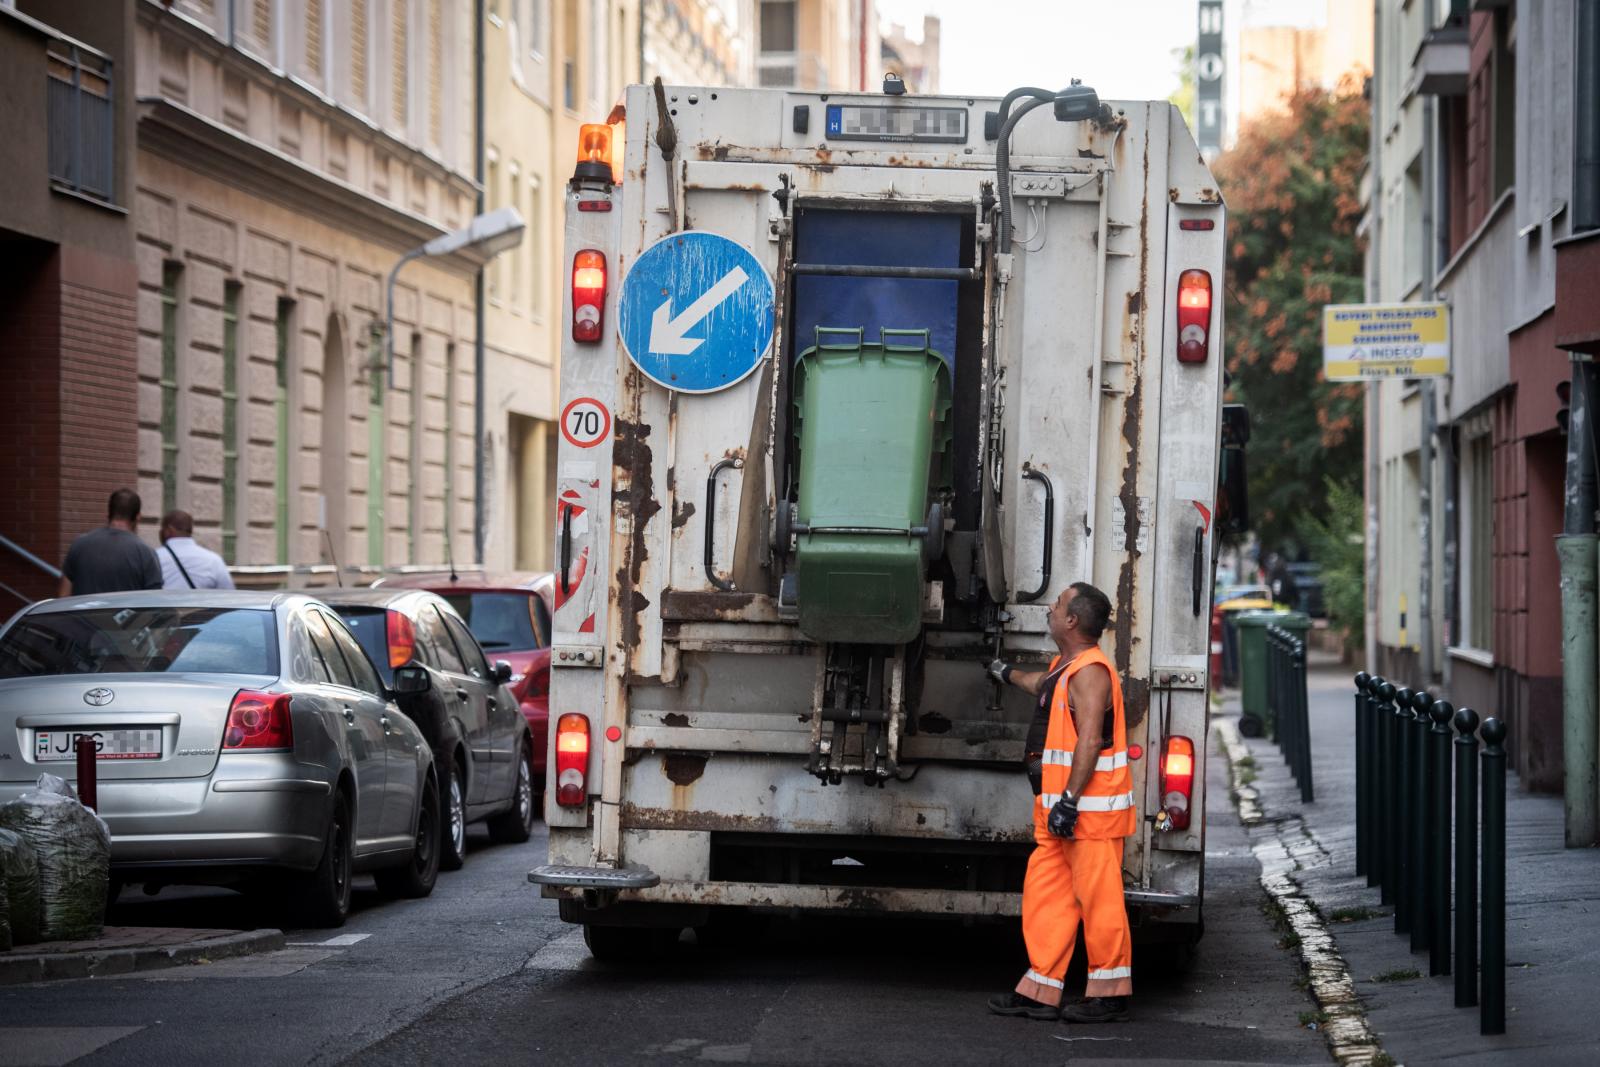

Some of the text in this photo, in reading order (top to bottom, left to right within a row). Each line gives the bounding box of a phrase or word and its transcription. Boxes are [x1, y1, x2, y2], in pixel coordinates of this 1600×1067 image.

[831, 122, 838, 131] H
[573, 411, 599, 435] 70
[39, 744, 48, 754] H
